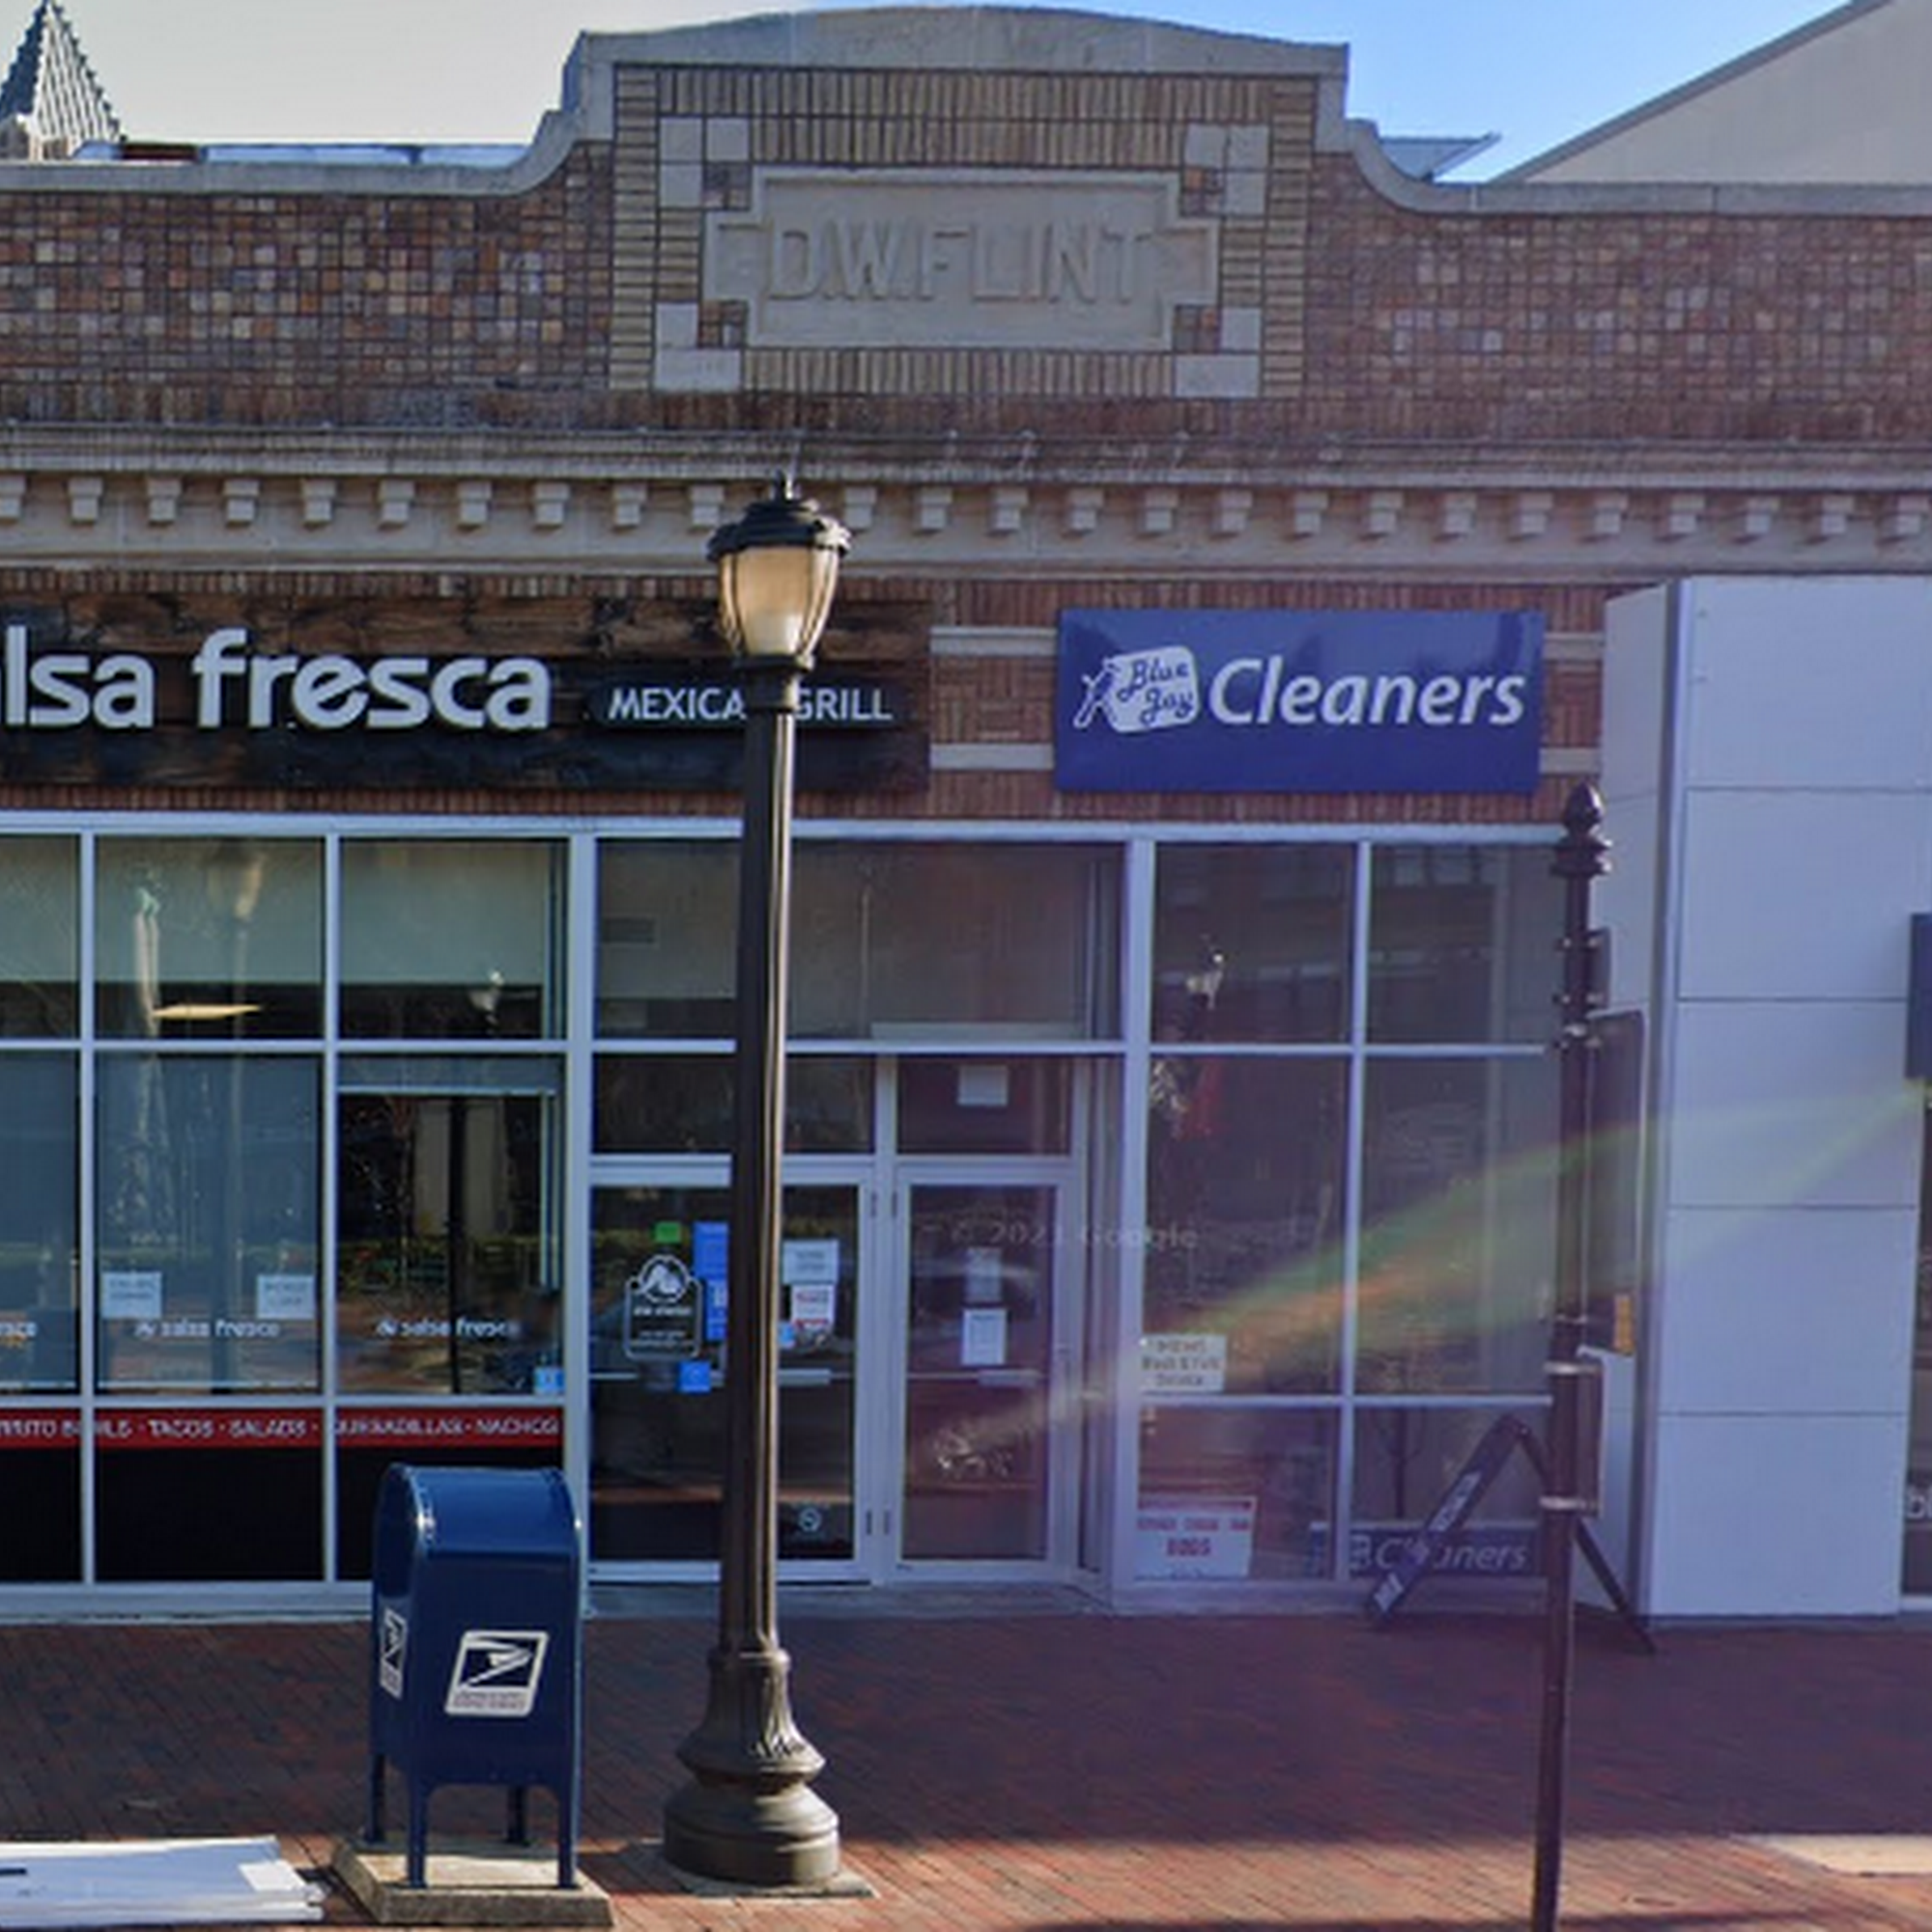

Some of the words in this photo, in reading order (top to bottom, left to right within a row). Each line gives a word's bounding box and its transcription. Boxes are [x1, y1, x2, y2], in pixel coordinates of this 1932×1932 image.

[193, 628, 552, 729] fresca
[608, 687, 747, 721] MEXICA
[1117, 658, 1189, 703] Blue
[1208, 655, 1526, 725] Cleaners
